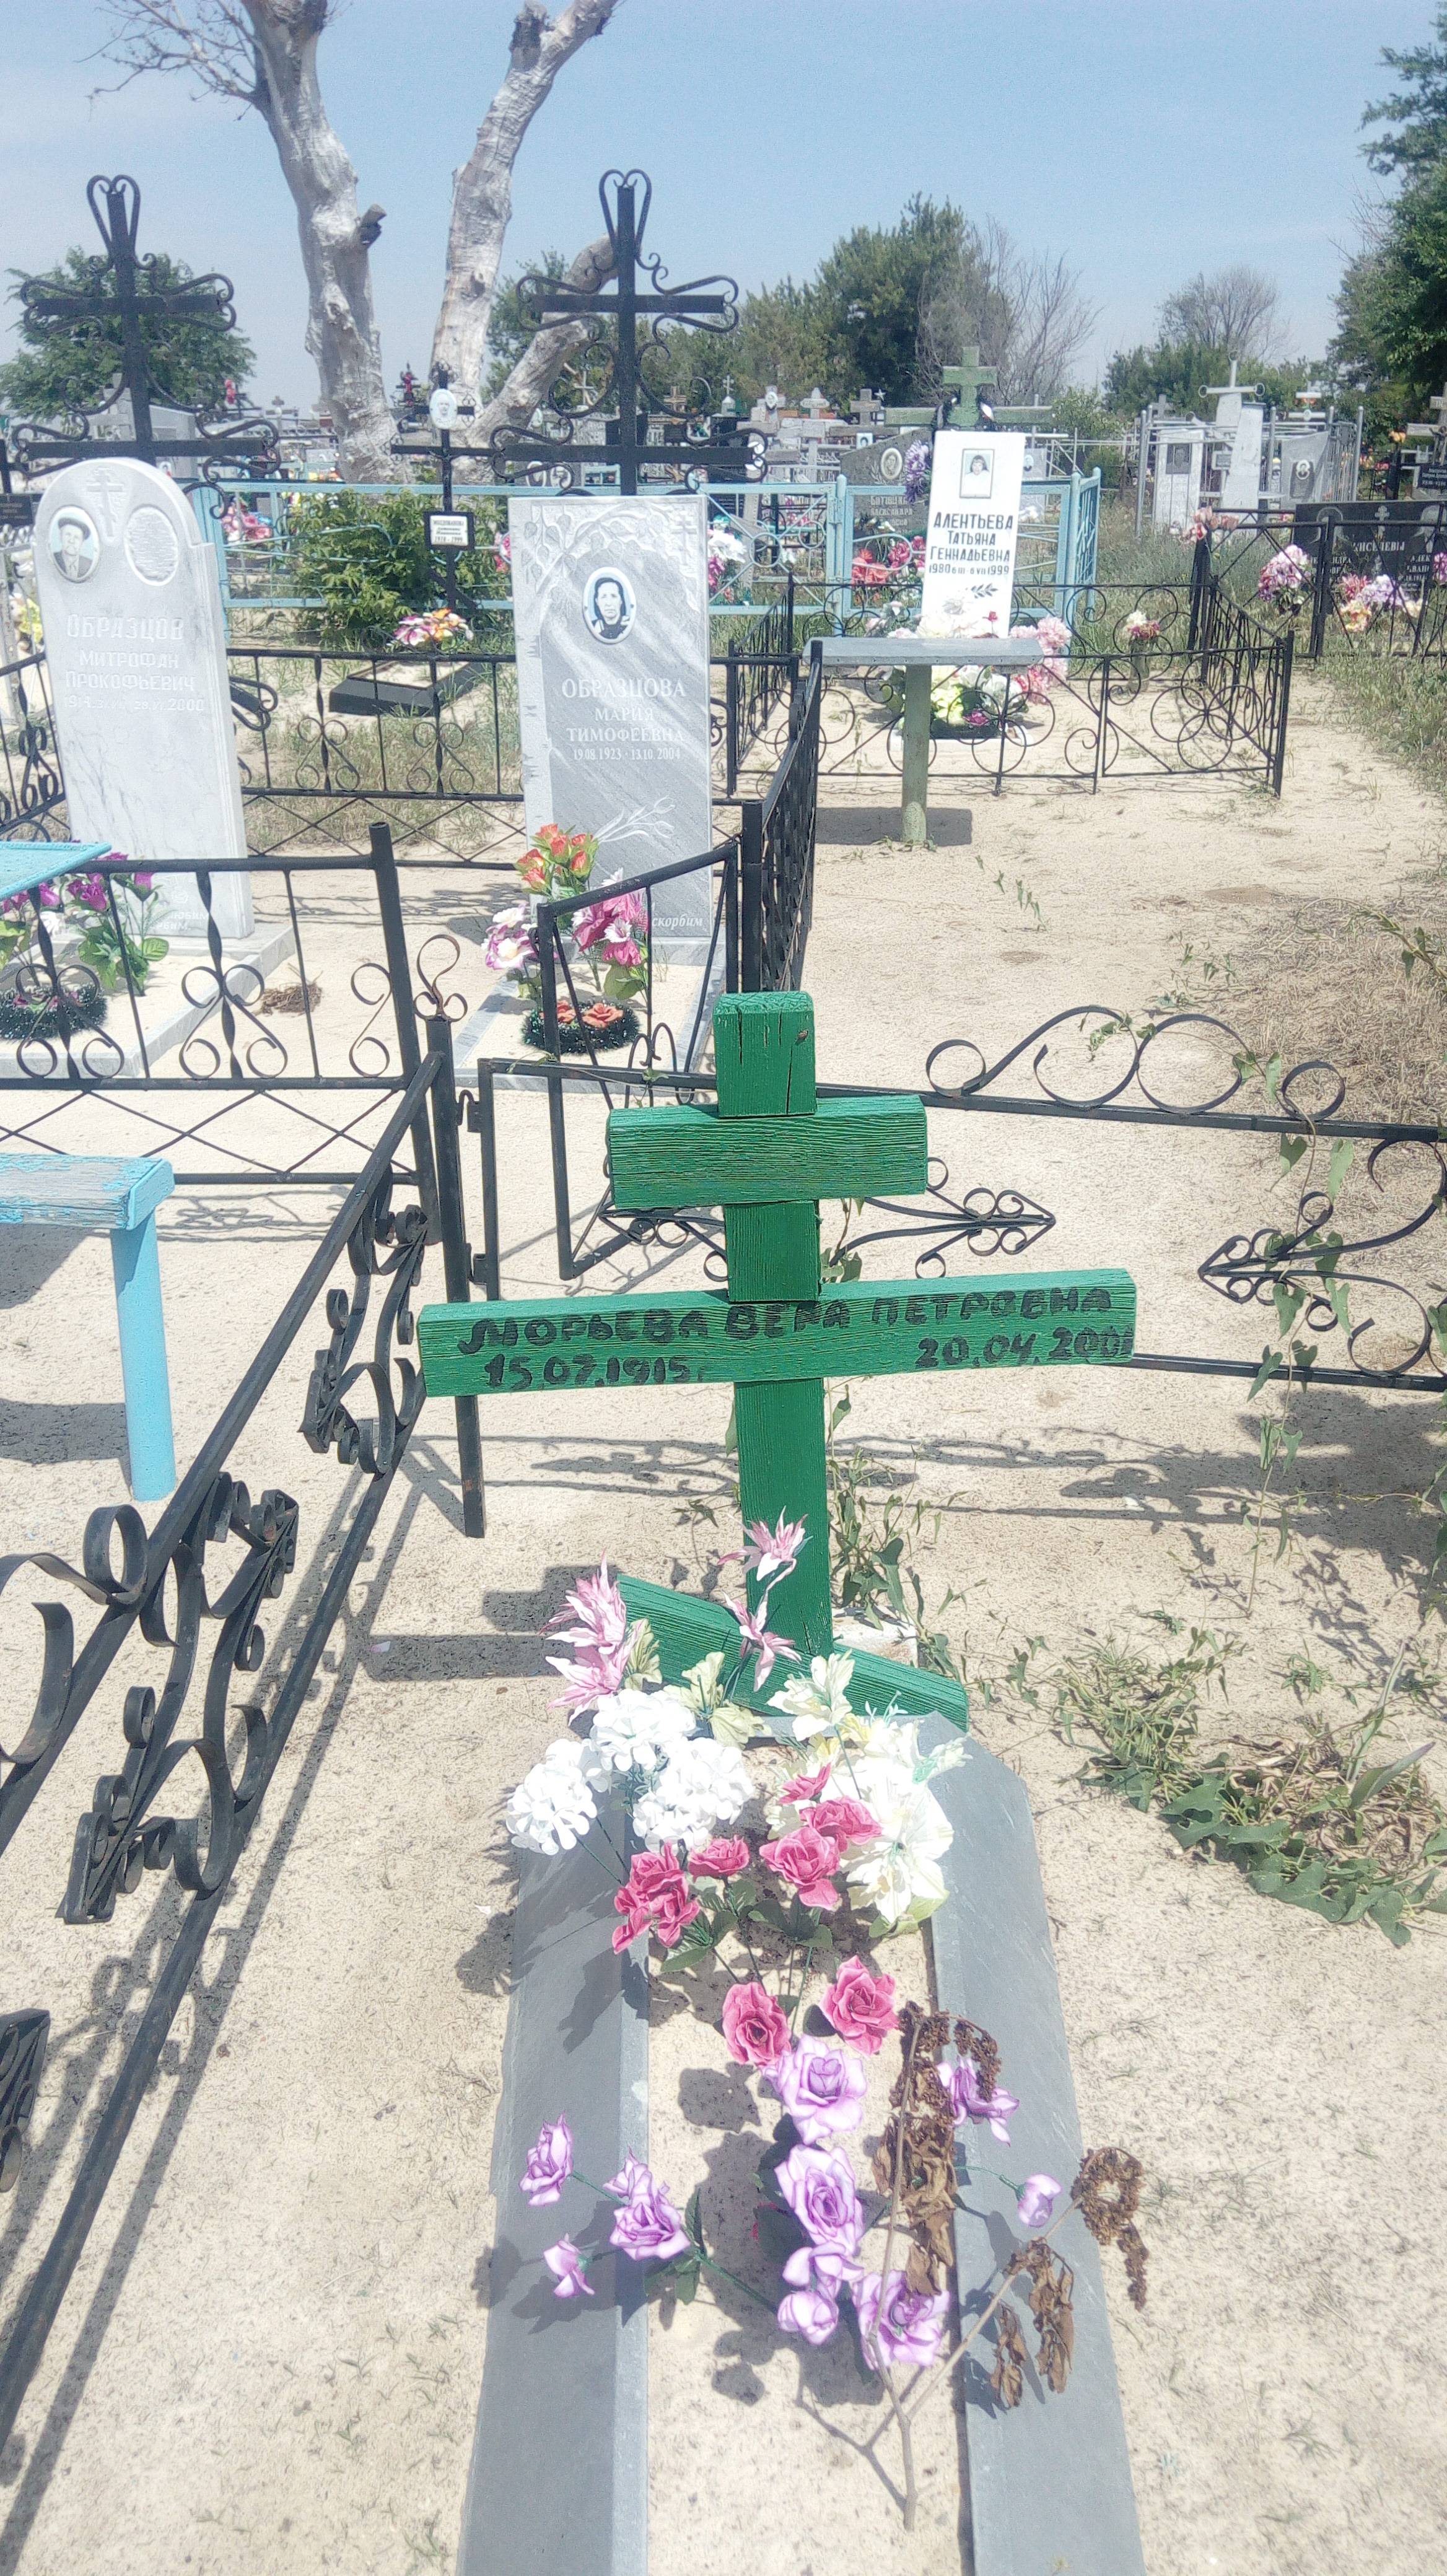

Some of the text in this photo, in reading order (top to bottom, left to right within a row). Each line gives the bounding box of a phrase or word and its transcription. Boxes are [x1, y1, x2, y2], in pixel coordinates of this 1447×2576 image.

[933, 511, 1013, 529] АЛЕНТЬЕВА
[948, 530, 996, 546] ТАТЬЯНА
[930, 546, 1010, 562] ГЕННАДЬЕВНА
[929, 564, 951, 573] 1980
[987, 565, 1010, 575] 1999
[67, 613, 185, 643] ОБРАЗЦОВ
[79, 649, 179, 669] МИТРОФАН
[66, 670, 196, 692] ПРОКОФЬЕВИЧ
[561, 677, 687, 703] ОБРАЗЦОВА
[595, 707, 654, 721] МАРИЯ
[566, 727, 684, 742] ТИМОФЕЕВНА
[652, 913, 704, 930] скорбим
[724, 1299, 851, 1341] ВЕРА
[872, 1287, 1112, 1327] ПЕТРОВНА
